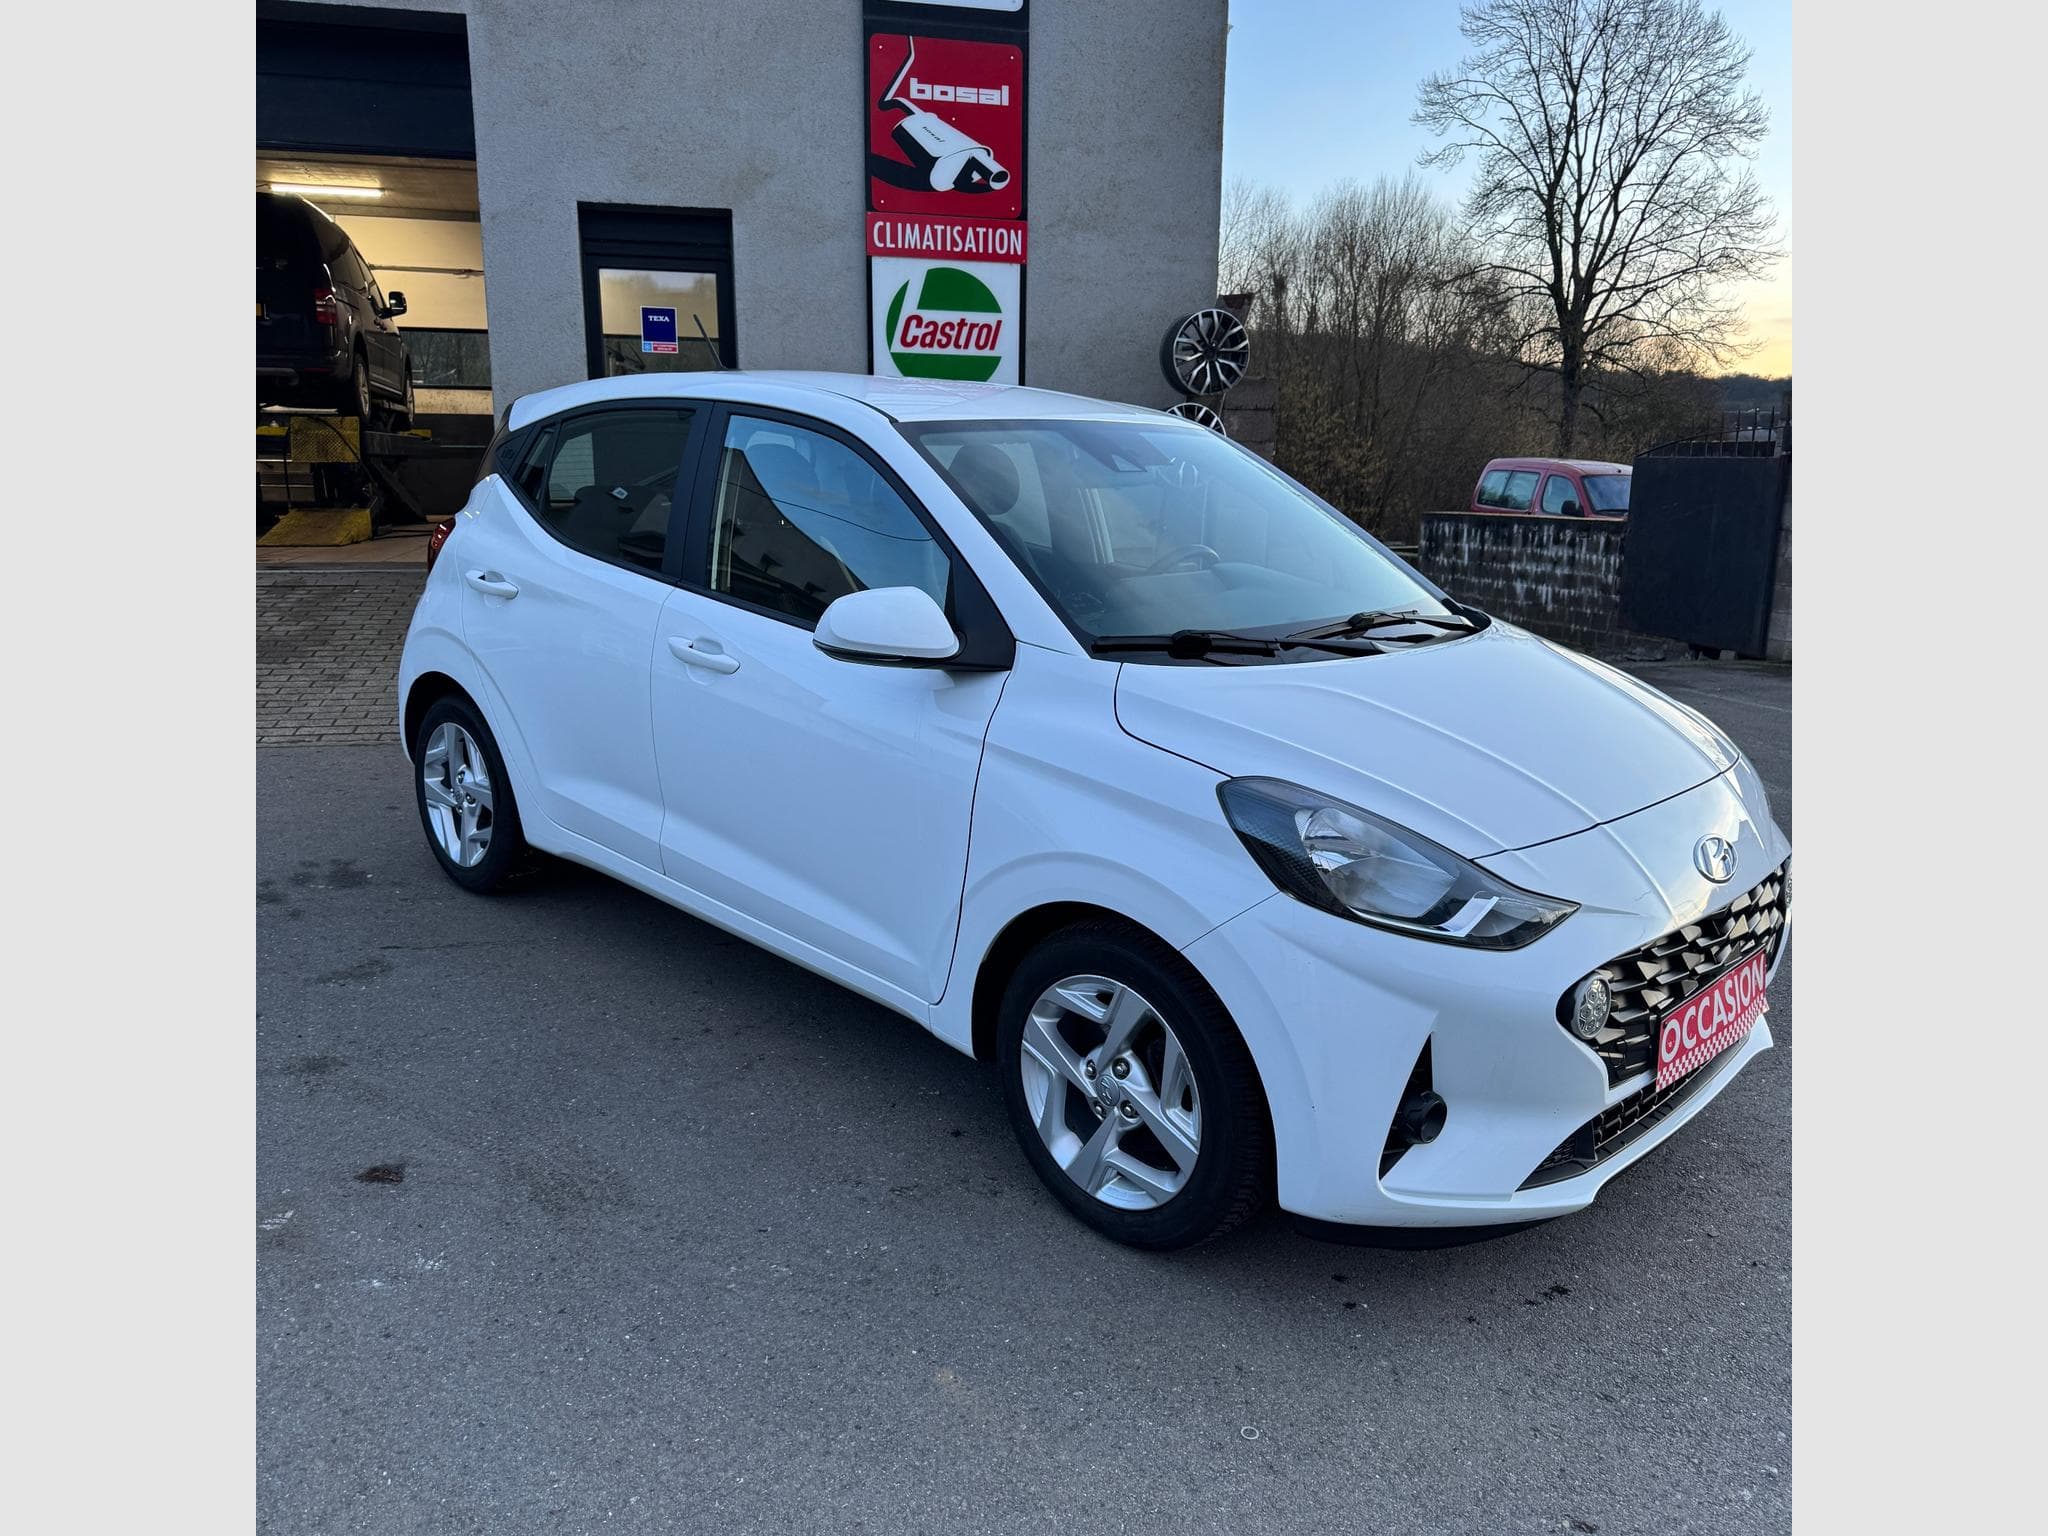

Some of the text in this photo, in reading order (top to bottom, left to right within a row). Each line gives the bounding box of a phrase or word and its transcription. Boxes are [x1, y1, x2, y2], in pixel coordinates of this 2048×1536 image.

[909, 77, 1010, 106] bosal
[873, 221, 1022, 256] CLIMATISATION
[900, 314, 1003, 351] Castrol
[1661, 953, 1765, 1063] OCCASION
